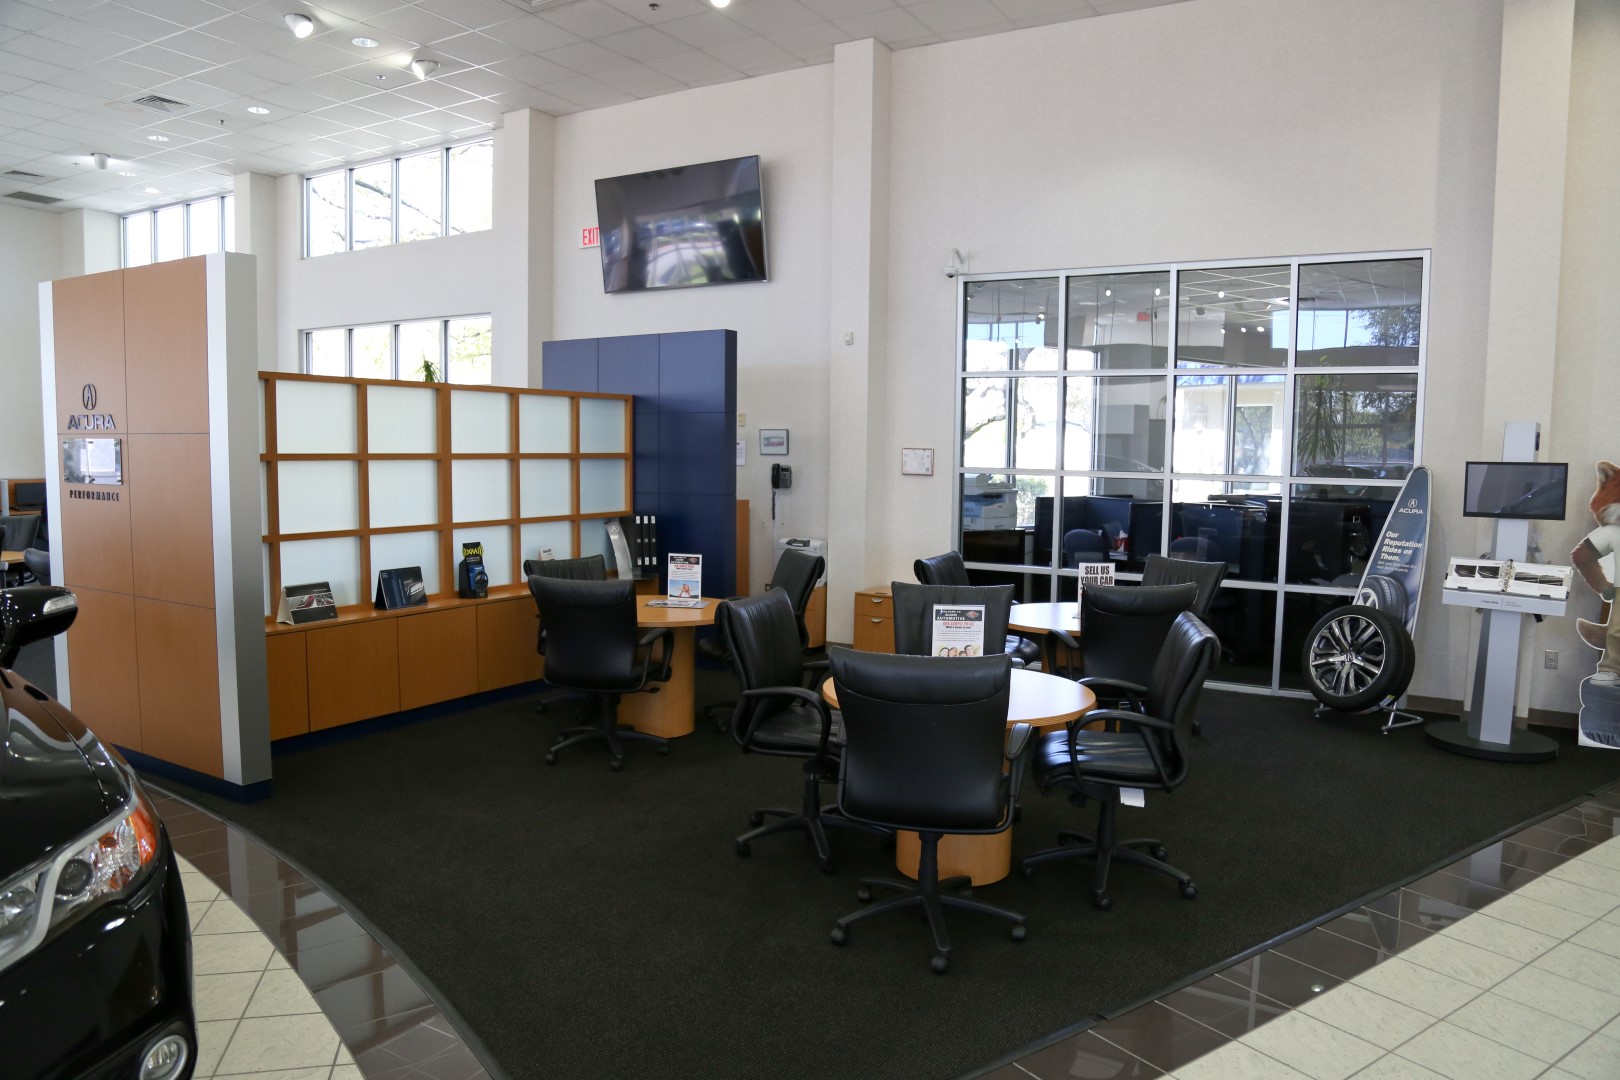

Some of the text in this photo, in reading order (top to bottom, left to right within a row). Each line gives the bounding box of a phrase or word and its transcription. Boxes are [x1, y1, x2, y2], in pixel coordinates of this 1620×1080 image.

[582, 226, 600, 246] EXIT
[67, 414, 116, 430] ACURA
[69, 489, 120, 502] PERFORMANCE
[1398, 507, 1424, 515] ACURA
[1385, 530, 1399, 538] Our
[1383, 538, 1423, 549] Reputation
[1381, 545, 1402, 554] Rides
[1380, 552, 1401, 561] Them.
[1084, 565, 1110, 575] SELL US
[1080, 576, 1114, 585] YOUR CAR
